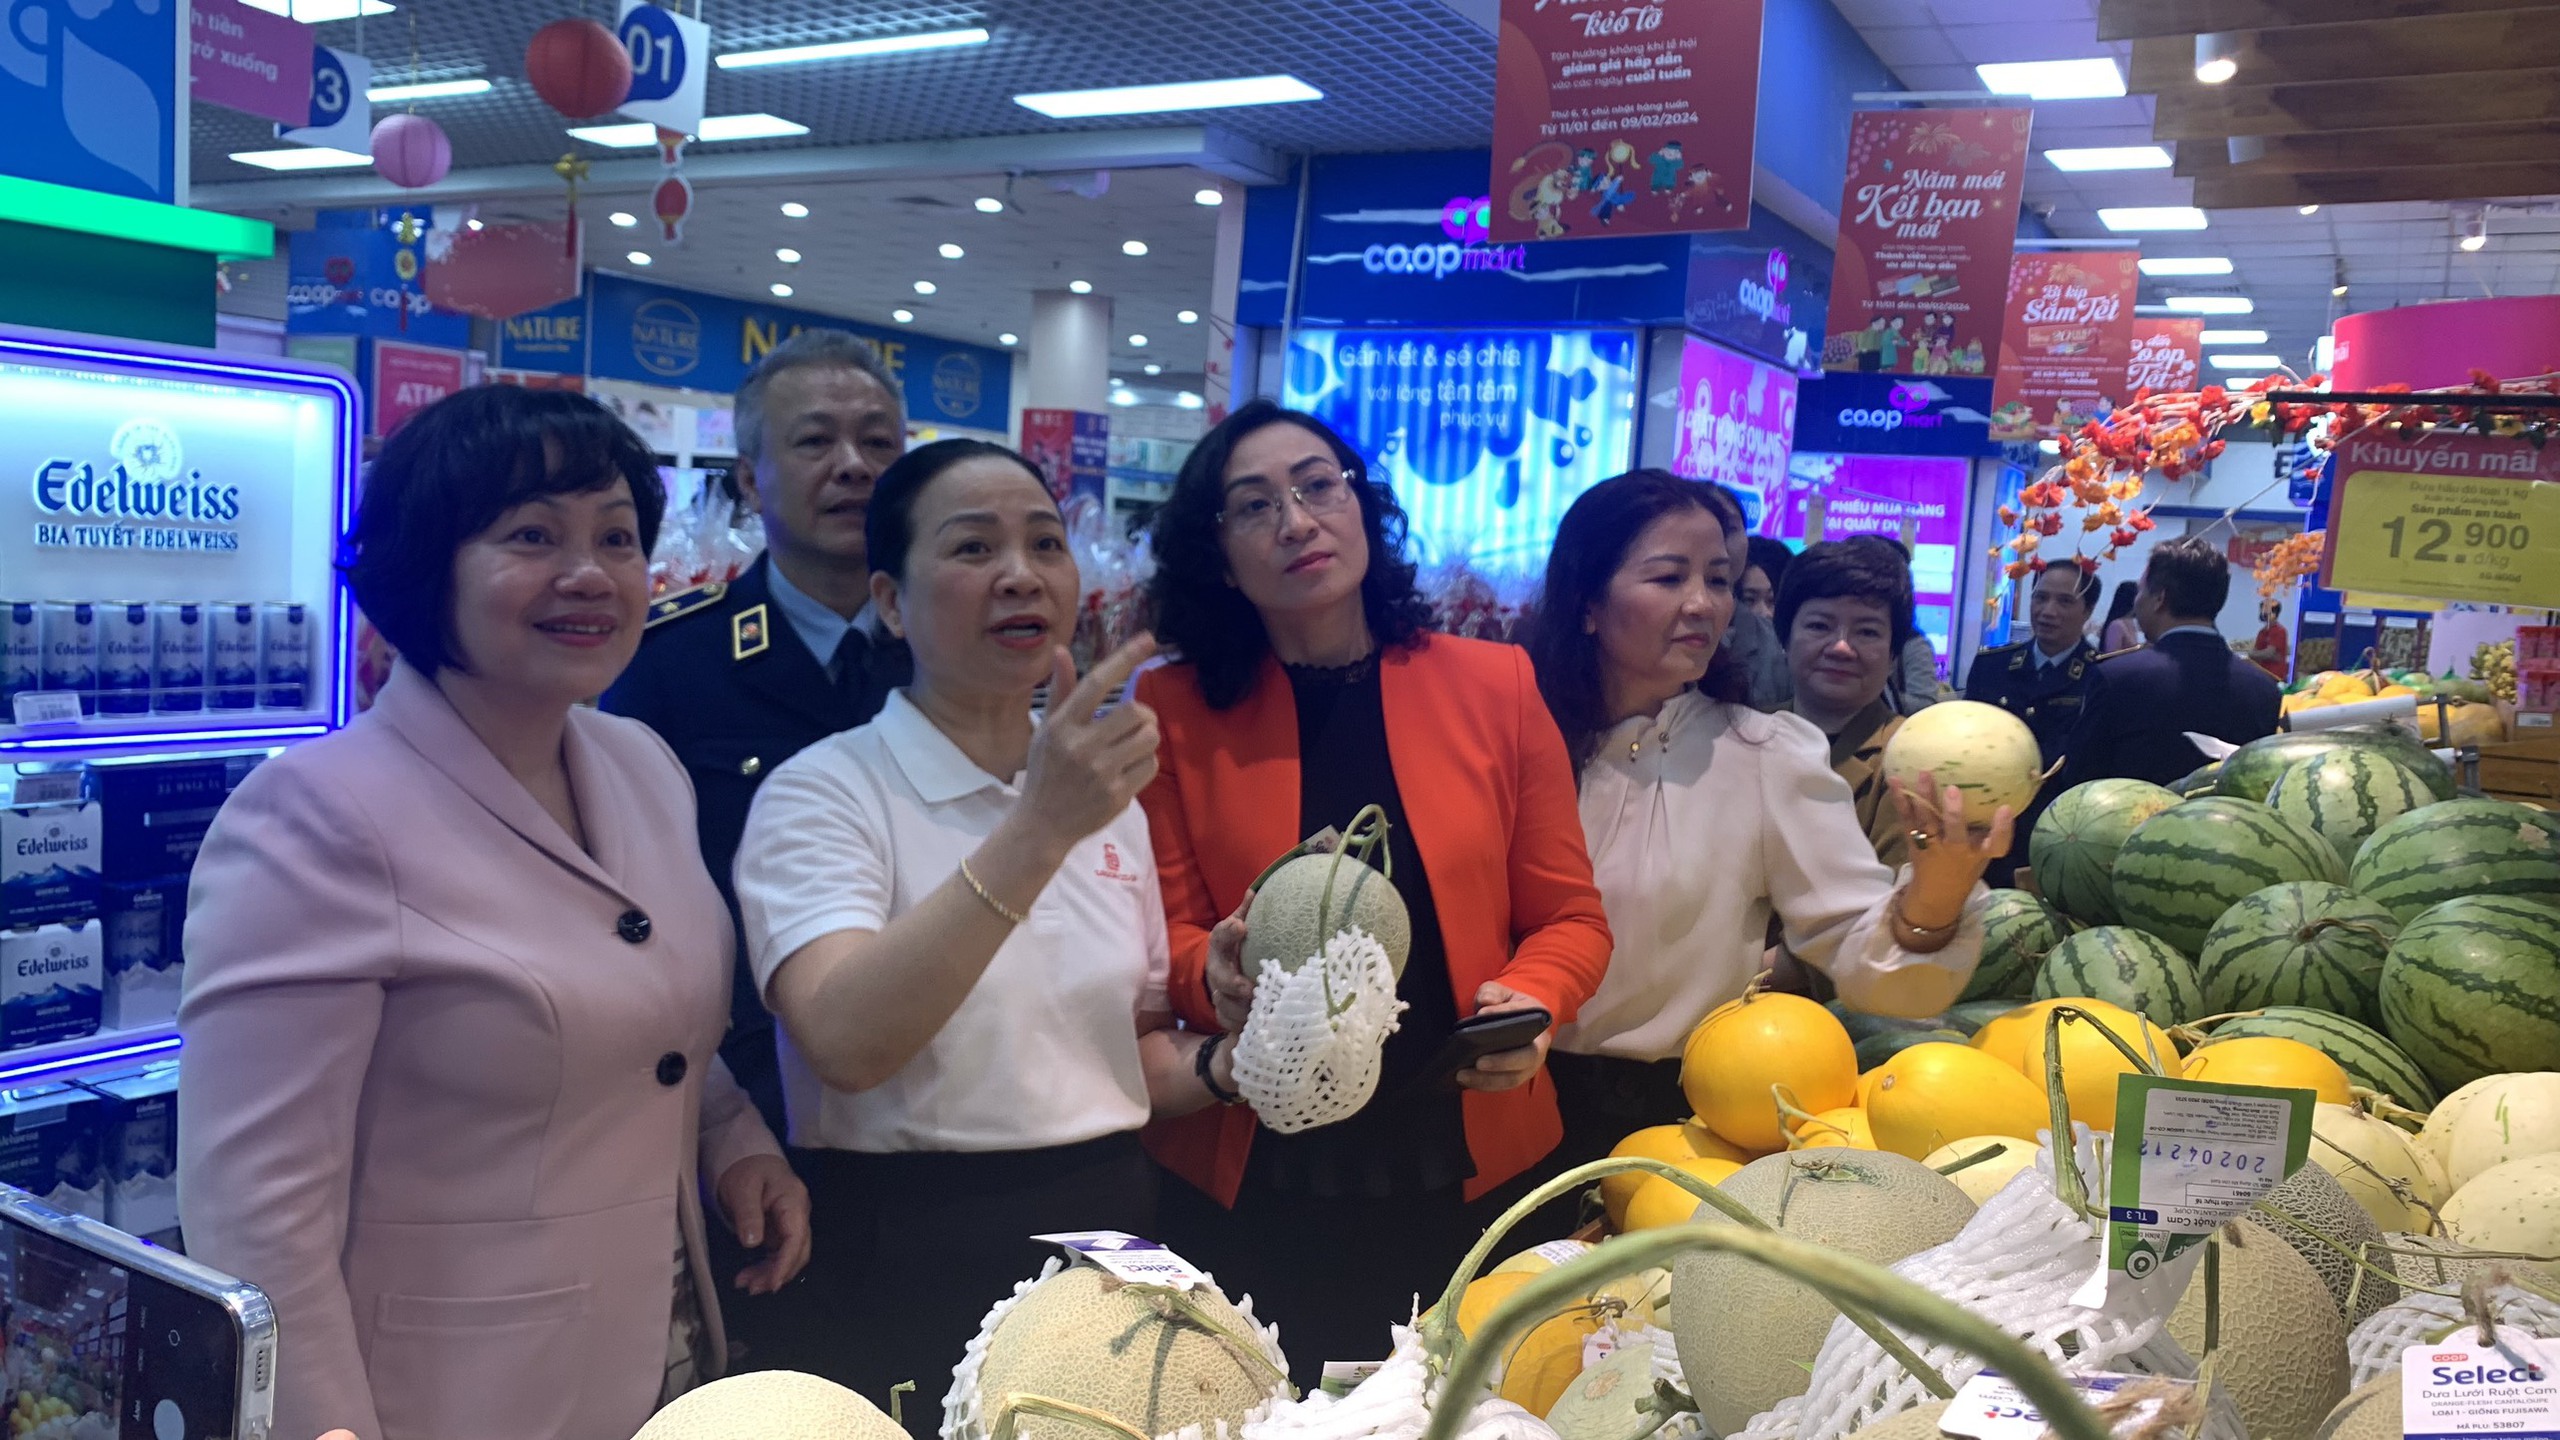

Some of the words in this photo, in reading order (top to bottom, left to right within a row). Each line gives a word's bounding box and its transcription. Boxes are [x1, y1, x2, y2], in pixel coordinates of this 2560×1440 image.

[208, 14, 244, 39] tiền
[626, 24, 672, 84] 01
[1610, 43, 1645, 56] không
[220, 49, 278, 82] xuống
[1561, 61, 1596, 77] giảm
[1599, 58, 1622, 73] giá
[1624, 55, 1652, 70] hấp
[1655, 51, 1683, 65] dẫn
[311, 68, 343, 112] 3
[1560, 119, 1589, 134] 11/01
[1592, 115, 1618, 131] đến
[1621, 111, 1699, 130] 09/02/2024
[1903, 169, 1957, 191] Năm
[1962, 170, 2006, 190] mới
[1855, 184, 1920, 228] Kết
[1923, 191, 1984, 223] bạn
[1896, 218, 1942, 238] mới
[2022, 297, 2079, 325] Sắm
[2077, 294, 2121, 325] Tết
[1423, 345, 1439, 367] &
[1476, 341, 1521, 367] chia
[2351, 441, 2469, 472] Khuyến
[2480, 449, 2539, 473] mãi
[35, 459, 240, 521] Edelweiss
[1872, 502, 1902, 515] MUA
[2411, 503, 2434, 514] Sản
[2437, 505, 2472, 518] phẩm
[2475, 509, 2490, 518] an
[36, 524, 69, 545] BIA
[74, 520, 135, 547] TUYẾT
[141, 526, 239, 550] EDELWEISS
[16, 834, 88, 856] Edelweiss
[17, 954, 89, 977] Edelweiss
[2174, 1208, 2217, 1216] CANTALOUPE
[2204, 1198, 2219, 1206] thực
[2126, 1210, 2132, 1218] 3
[2135, 1210, 2147, 1220] TL
[2167, 1217, 2191, 1226] Cam
[2194, 1217, 2217, 1228] Ruột
[2433, 1354, 2468, 1362] COOP
[2432, 1364, 2544, 1386] Select
[2422, 1390, 2450, 1399] Dưa
[2454, 1388, 2485, 1398] Lưới
[2488, 1387, 2519, 1398] Ruột
[2524, 1386, 2557, 1396] Cam
[2432, 1409, 2454, 1417] LOẠI
[2502, 1407, 2549, 1415] FUJISAWA
[2493, 1421, 2525, 1430] 53807
